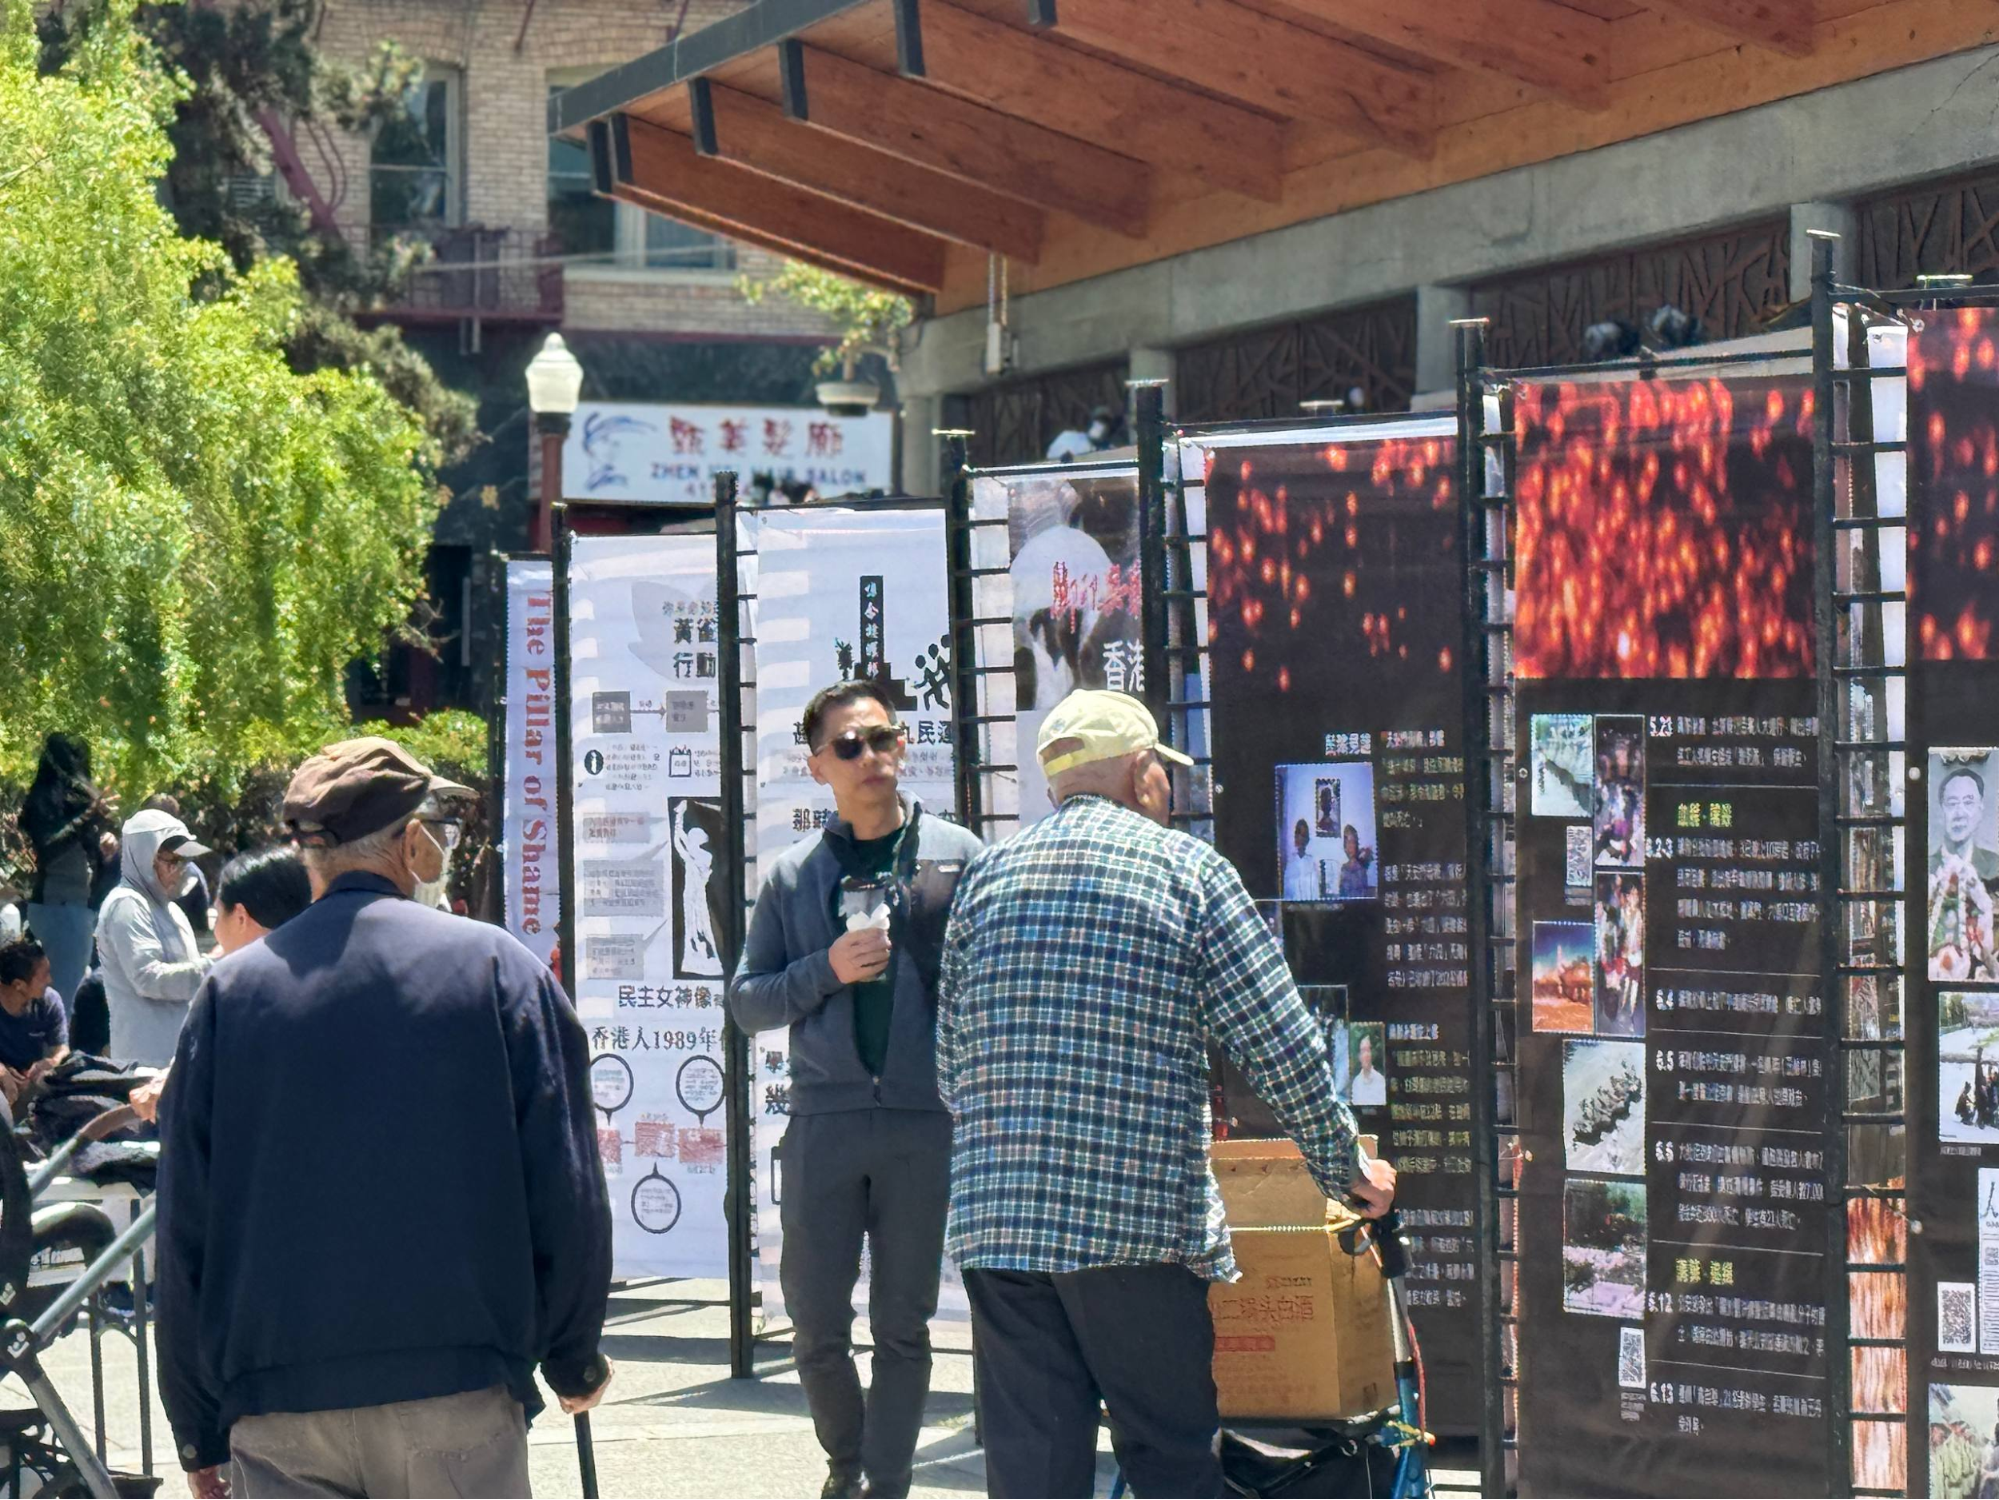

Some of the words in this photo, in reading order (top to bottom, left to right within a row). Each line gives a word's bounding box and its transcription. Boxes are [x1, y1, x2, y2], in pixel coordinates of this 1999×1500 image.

[806, 468, 867, 485] SALON
[527, 590, 554, 656] The
[673, 652, 716, 678] 行動
[524, 667, 551, 766] Pillar
[522, 819, 548, 935] Shame
